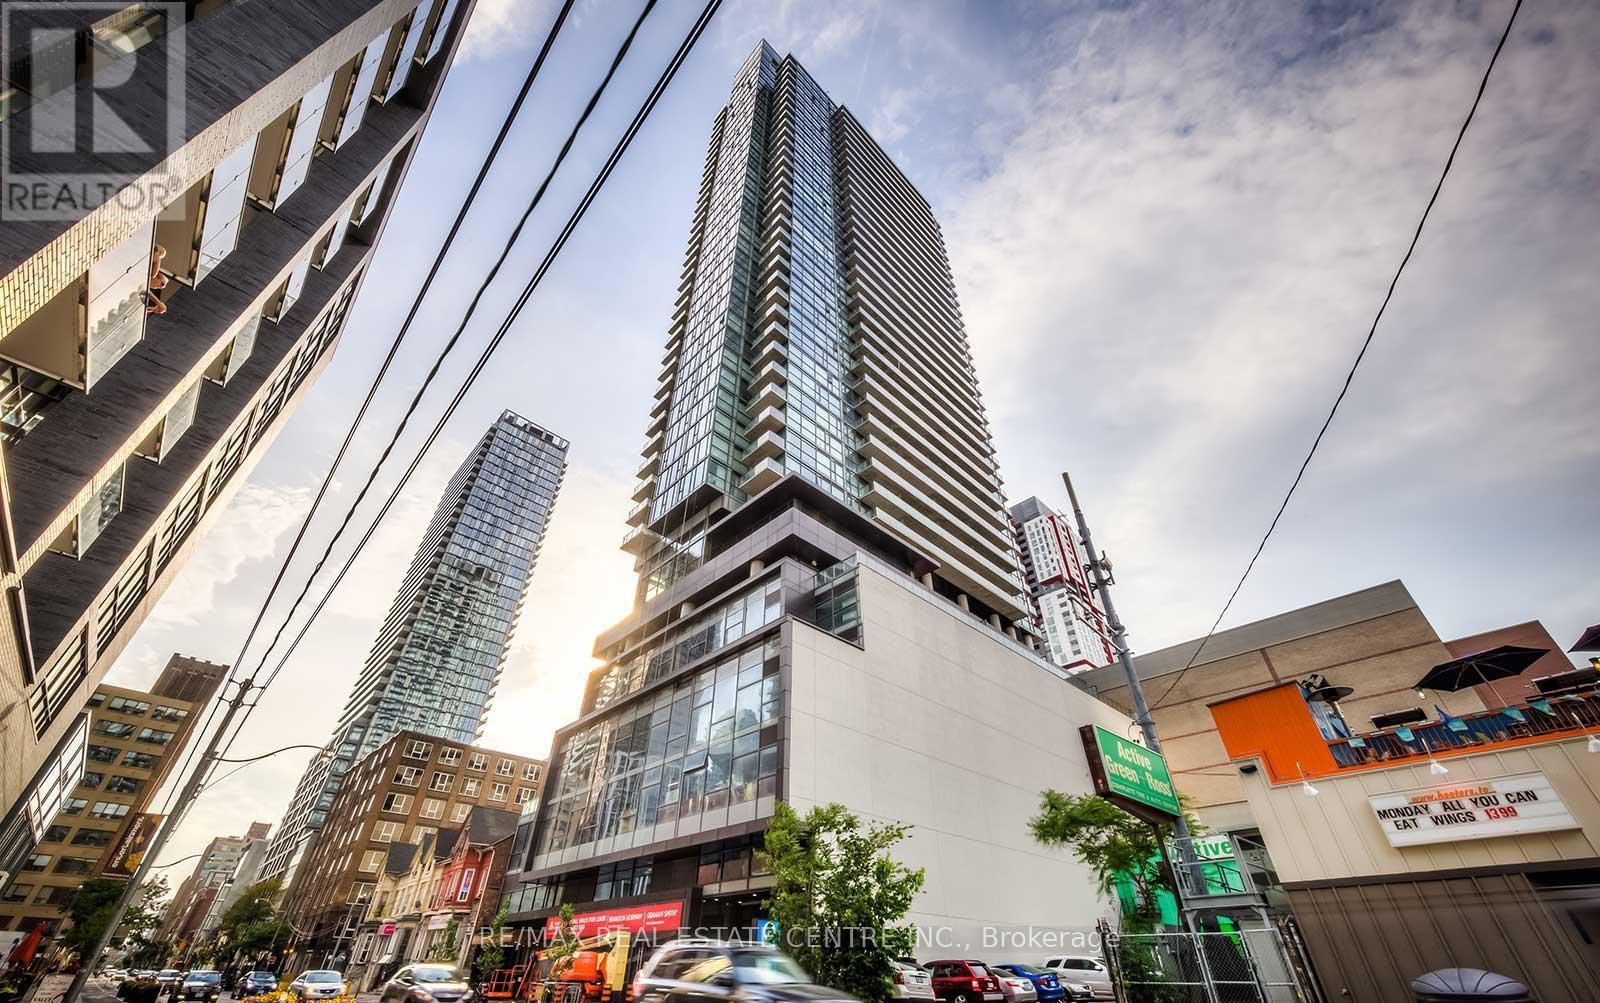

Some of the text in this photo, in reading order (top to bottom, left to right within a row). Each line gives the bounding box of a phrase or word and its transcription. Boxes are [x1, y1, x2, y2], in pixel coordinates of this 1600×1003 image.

[1117, 741, 1152, 771] Active
[1104, 754, 1140, 784] Green
[1145, 771, 1172, 797] Ross
[1377, 790, 1538, 821] MONDAY ALL YOU CAN
[1411, 786, 1489, 803] www.hooters.to
[1394, 806, 1518, 831] EAT WINGS 1399
[112, 816, 144, 868] entertainment
